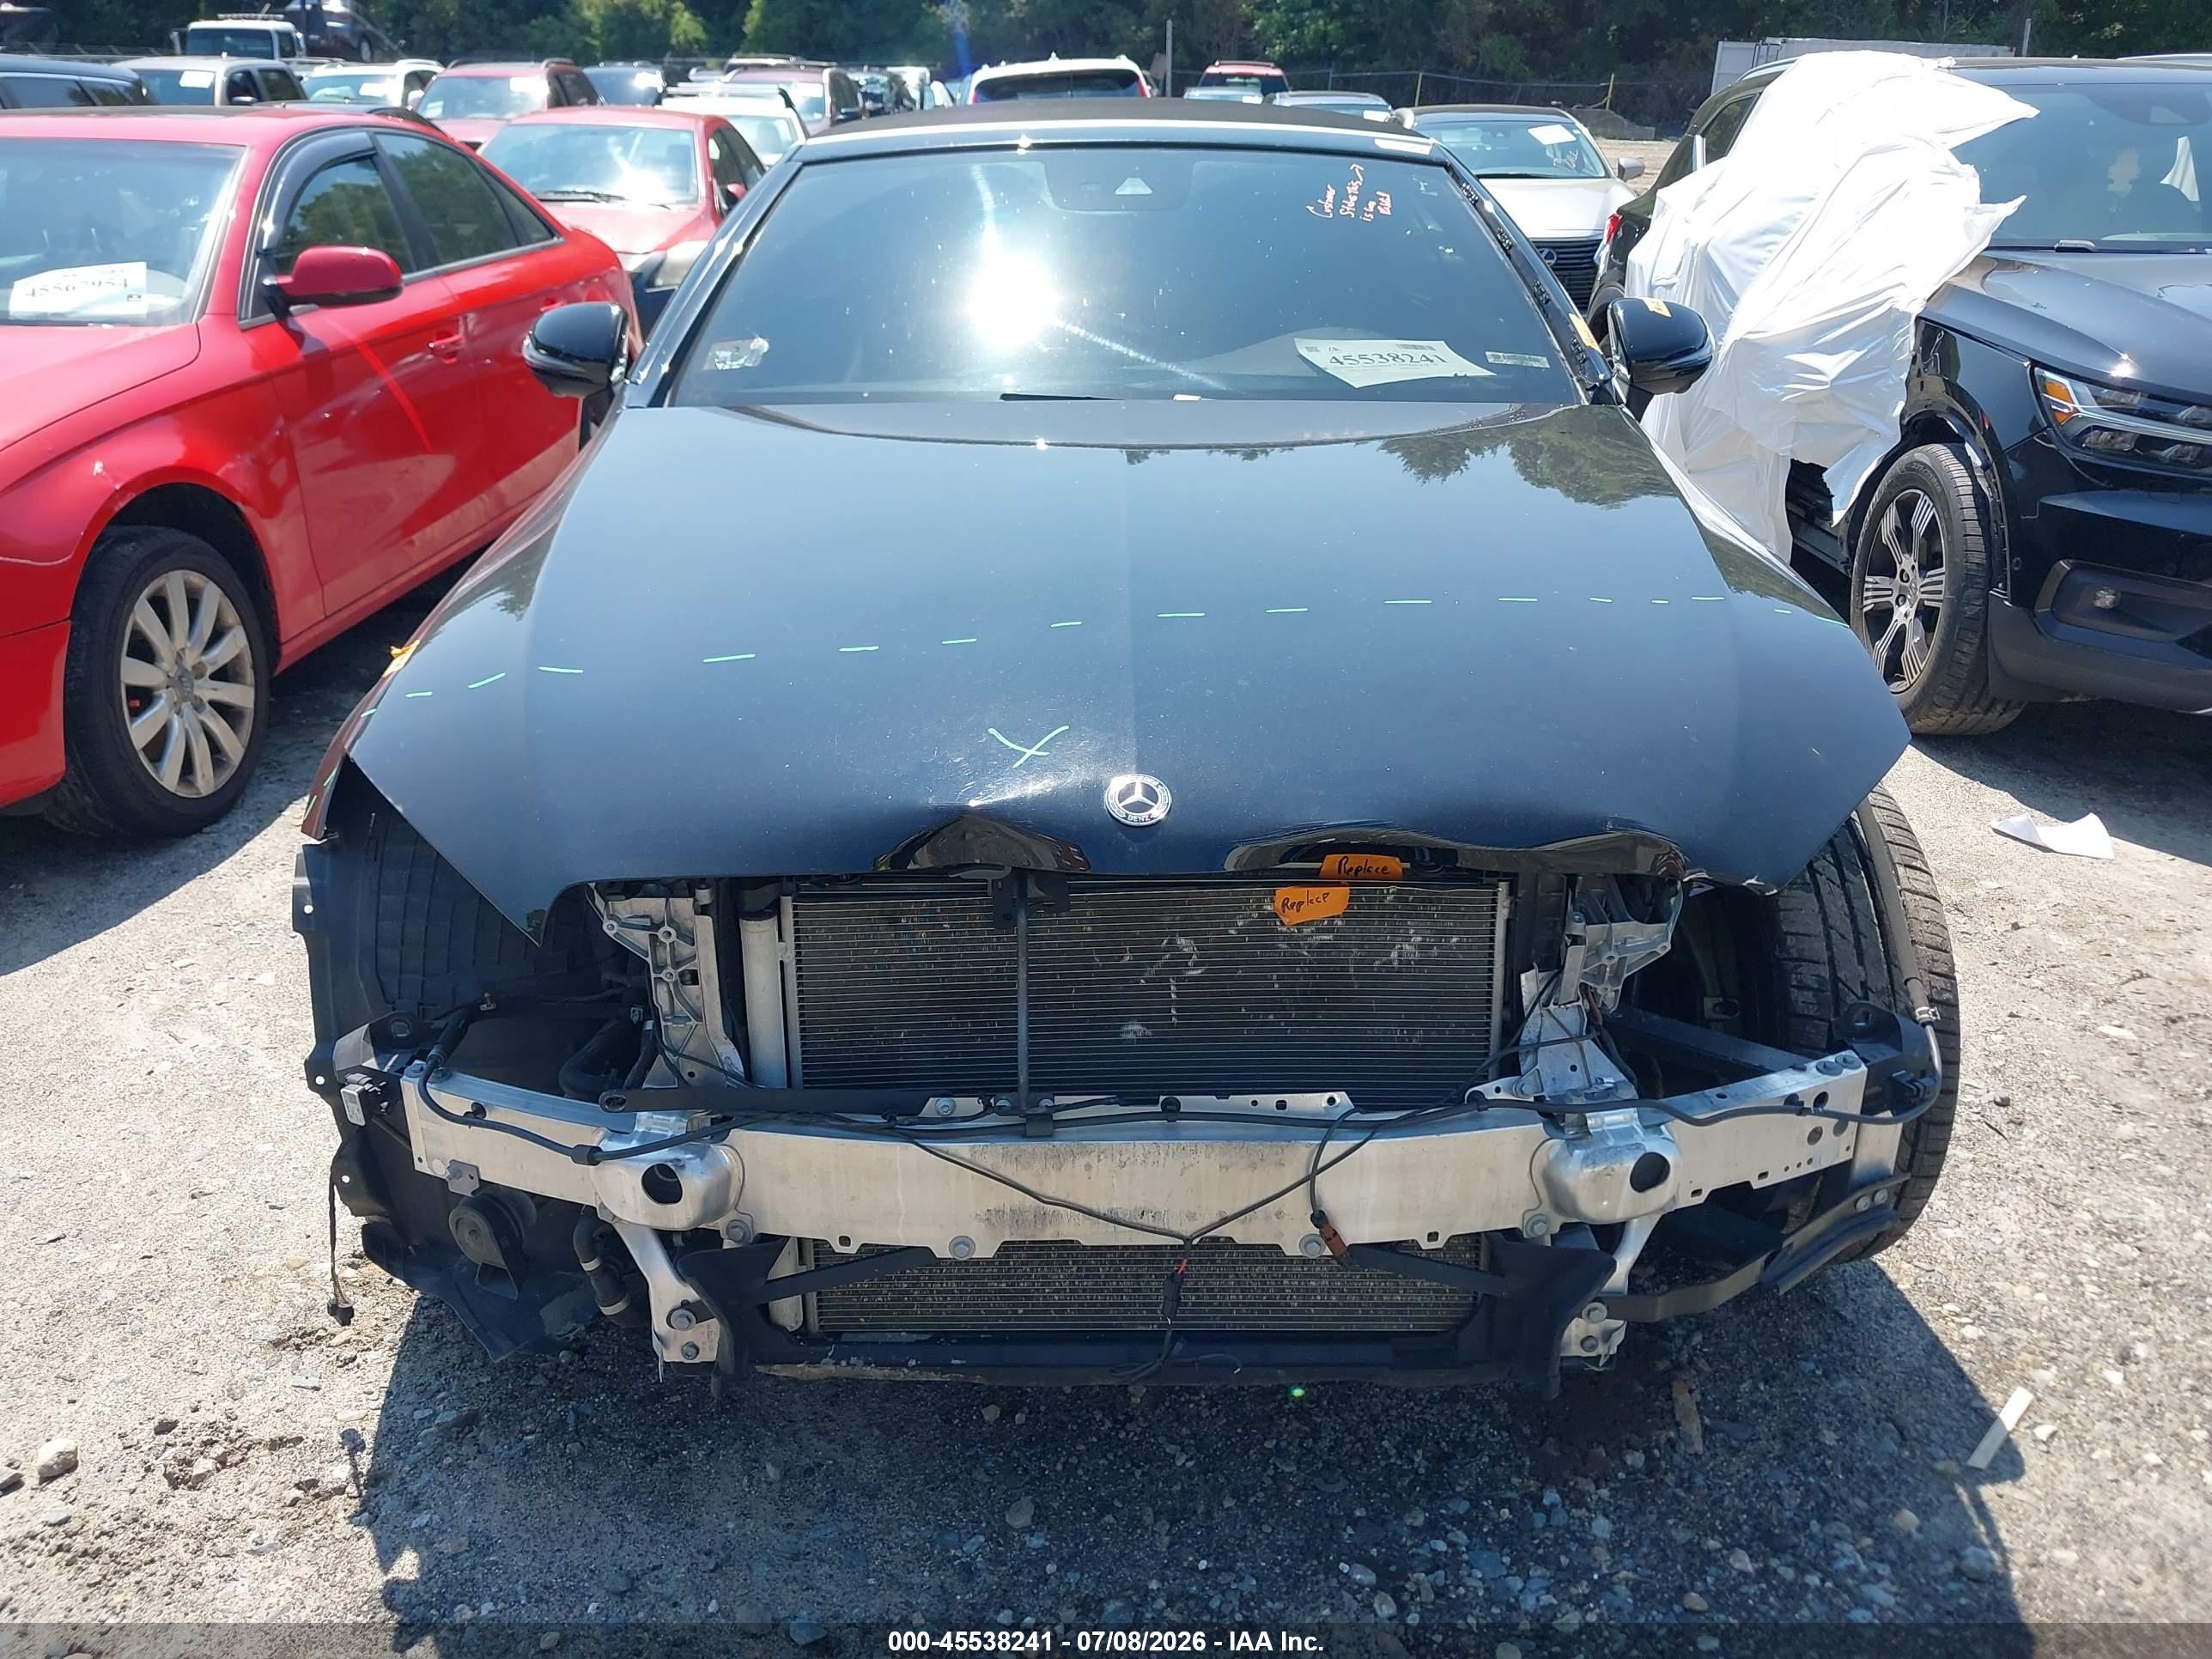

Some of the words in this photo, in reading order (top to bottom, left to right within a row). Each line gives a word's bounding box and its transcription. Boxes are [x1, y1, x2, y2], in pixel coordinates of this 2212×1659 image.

[1329, 353, 1449, 366] 45538241
[1337, 855, 1390, 877] Replace
[1280, 889, 1330, 914] Replace
